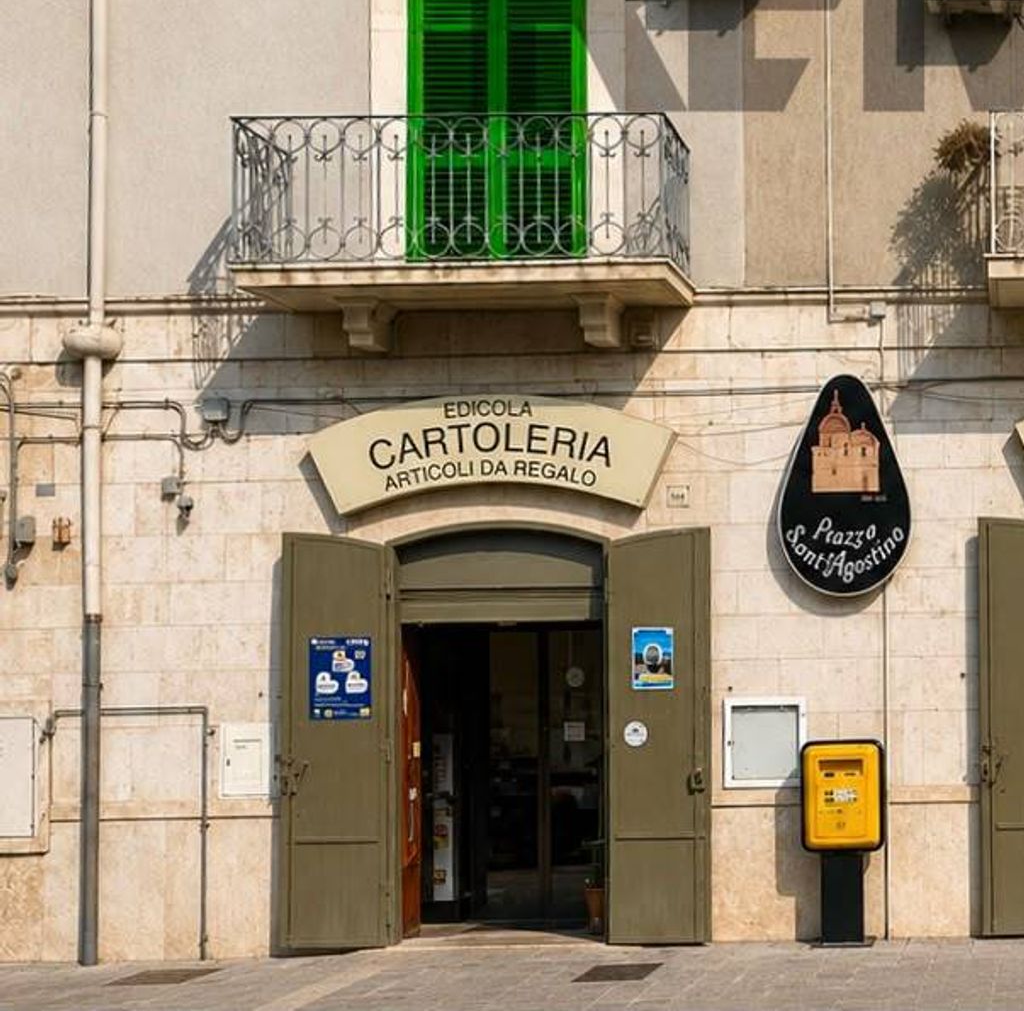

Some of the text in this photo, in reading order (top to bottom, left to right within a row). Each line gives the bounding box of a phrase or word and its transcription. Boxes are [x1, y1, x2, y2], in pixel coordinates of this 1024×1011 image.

[443, 399, 533, 419] EDICOLA
[368, 422, 612, 470] CARTOLERIA
[384, 459, 597, 492] ARTICOLI DA REGALO
